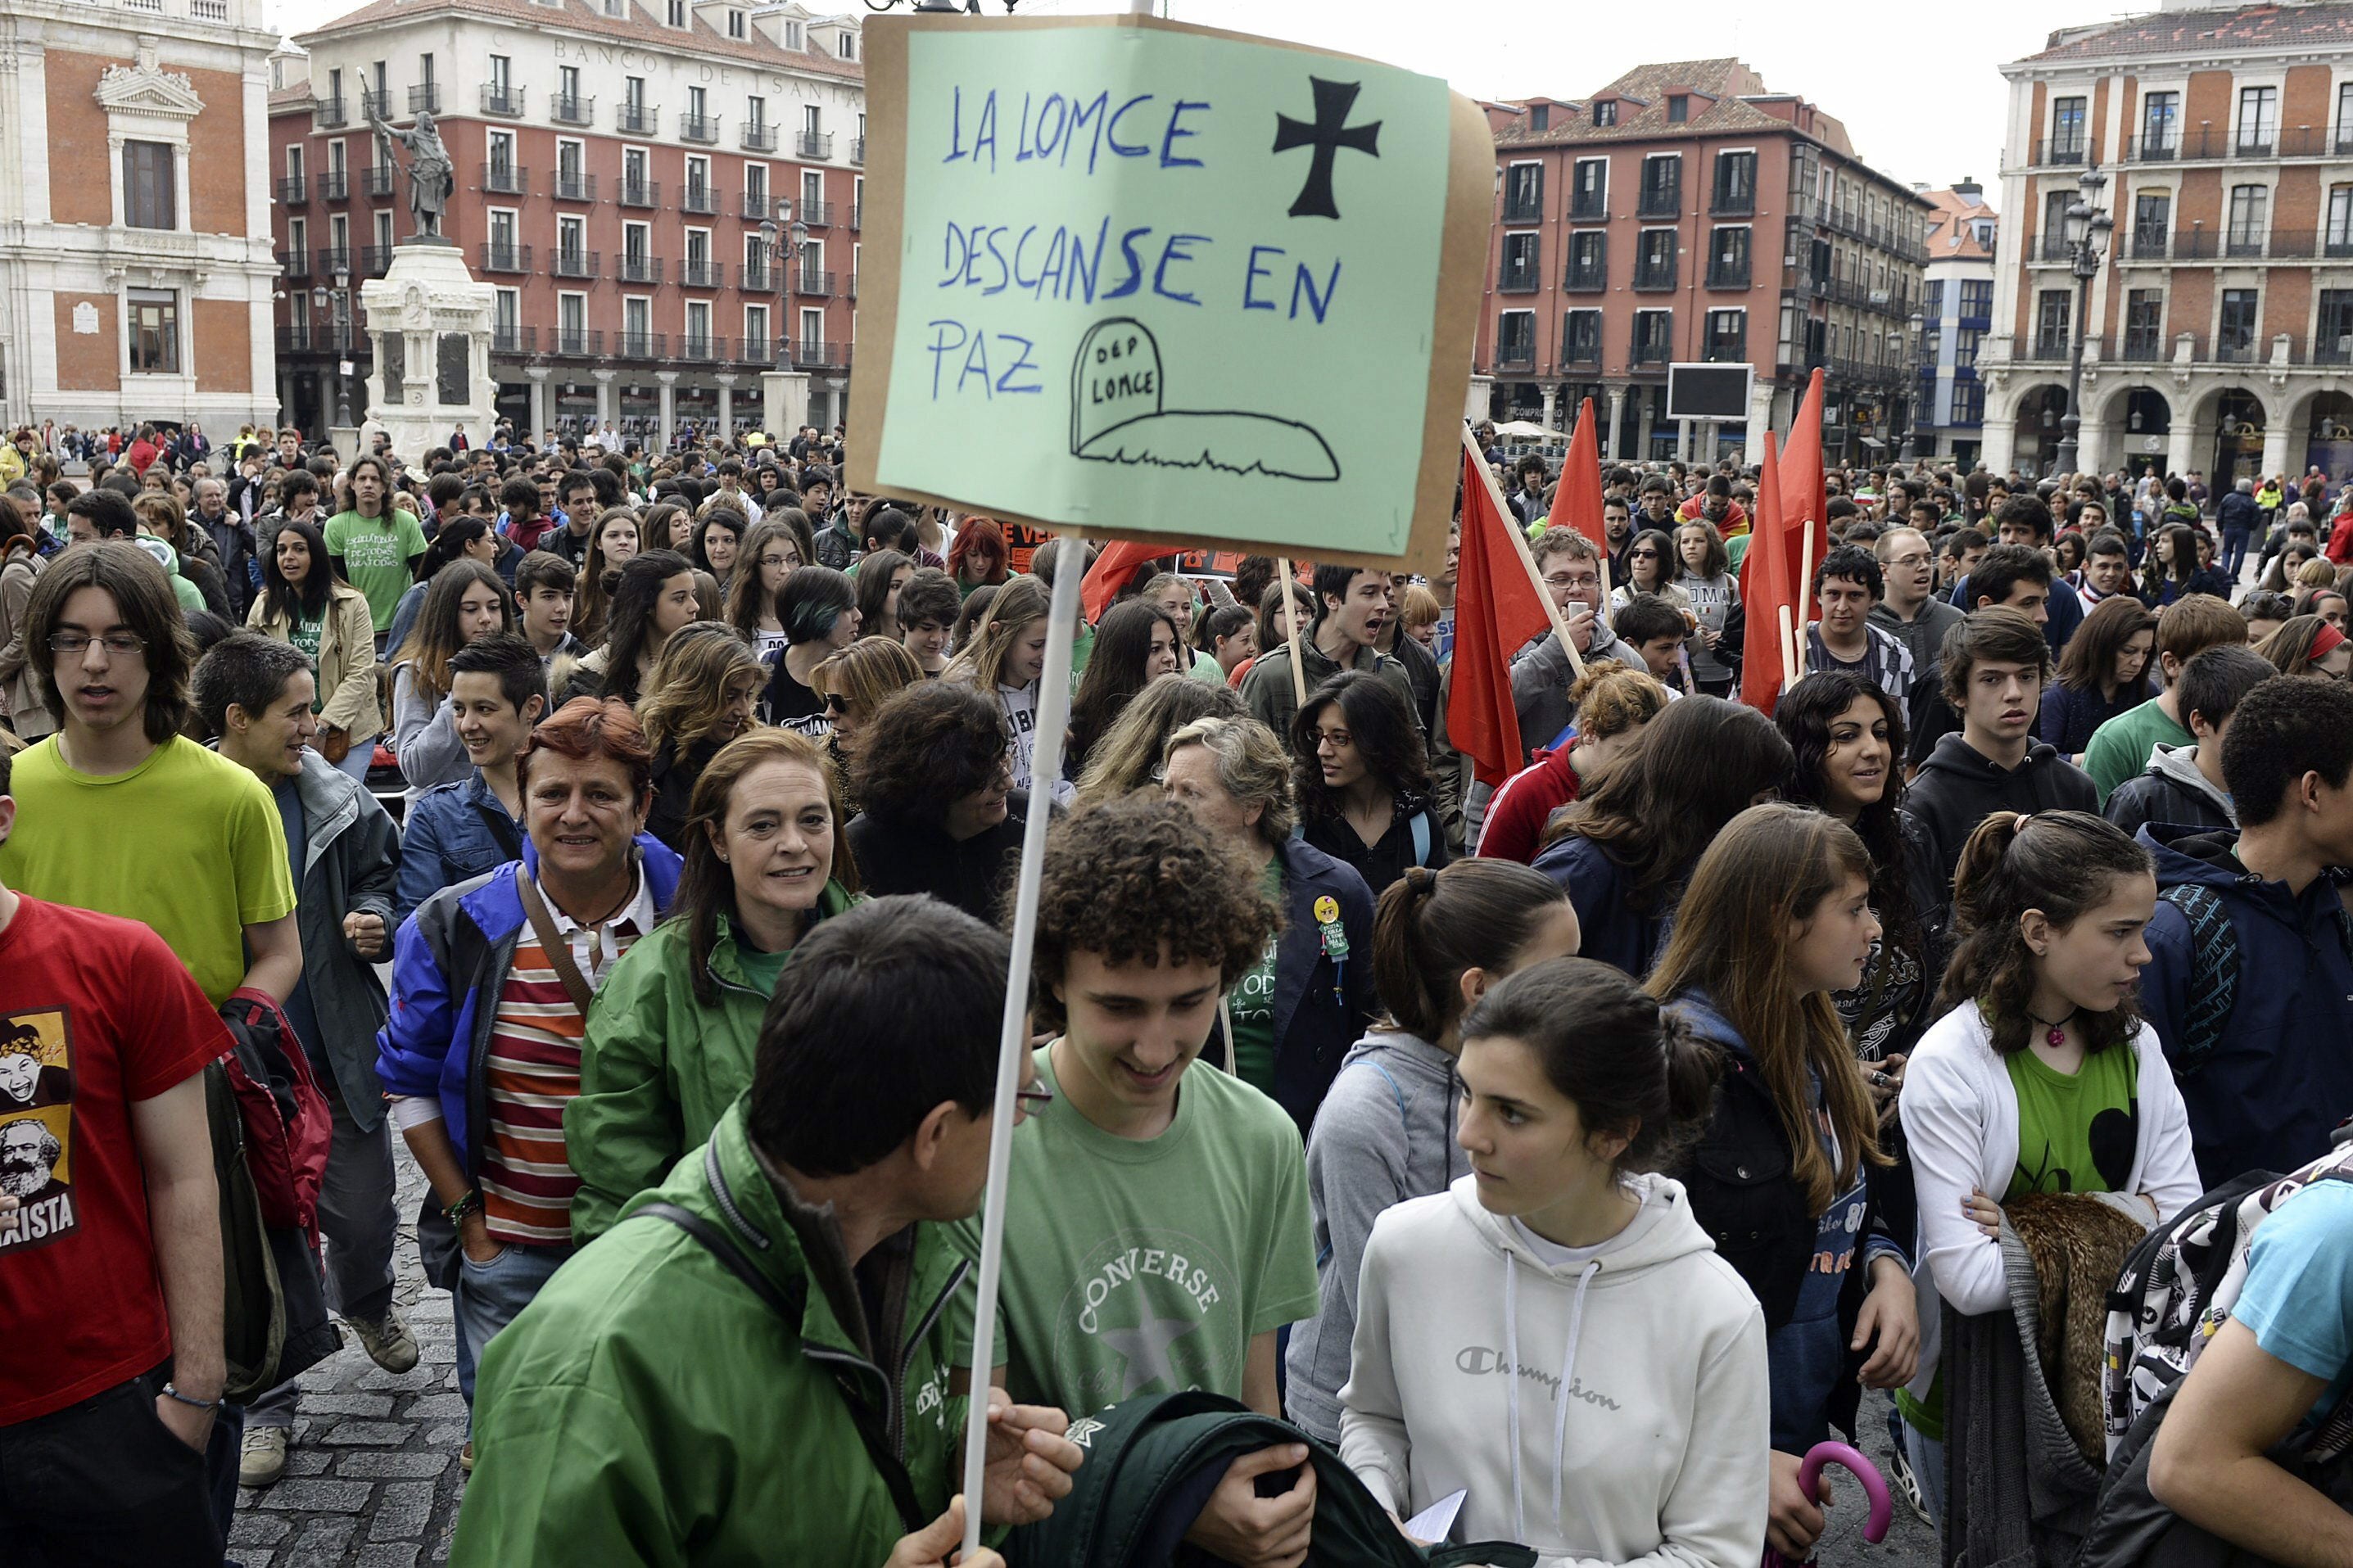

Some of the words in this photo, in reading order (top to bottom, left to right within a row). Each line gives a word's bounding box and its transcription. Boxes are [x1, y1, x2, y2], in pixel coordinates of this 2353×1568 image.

[554, 39, 658, 73] BANCO
[699, 64, 731, 86] DE
[943, 85, 998, 174] LA
[1015, 90, 1211, 175] LOMCE
[938, 215, 1213, 305] DESCANSE
[1243, 245, 1342, 324] EN
[927, 319, 1044, 401] PAZ
[1093, 371, 1153, 404] LOMCE
[1079, 1247, 1220, 1335] CONVERSE
[1455, 1345, 1622, 1412] Champion
